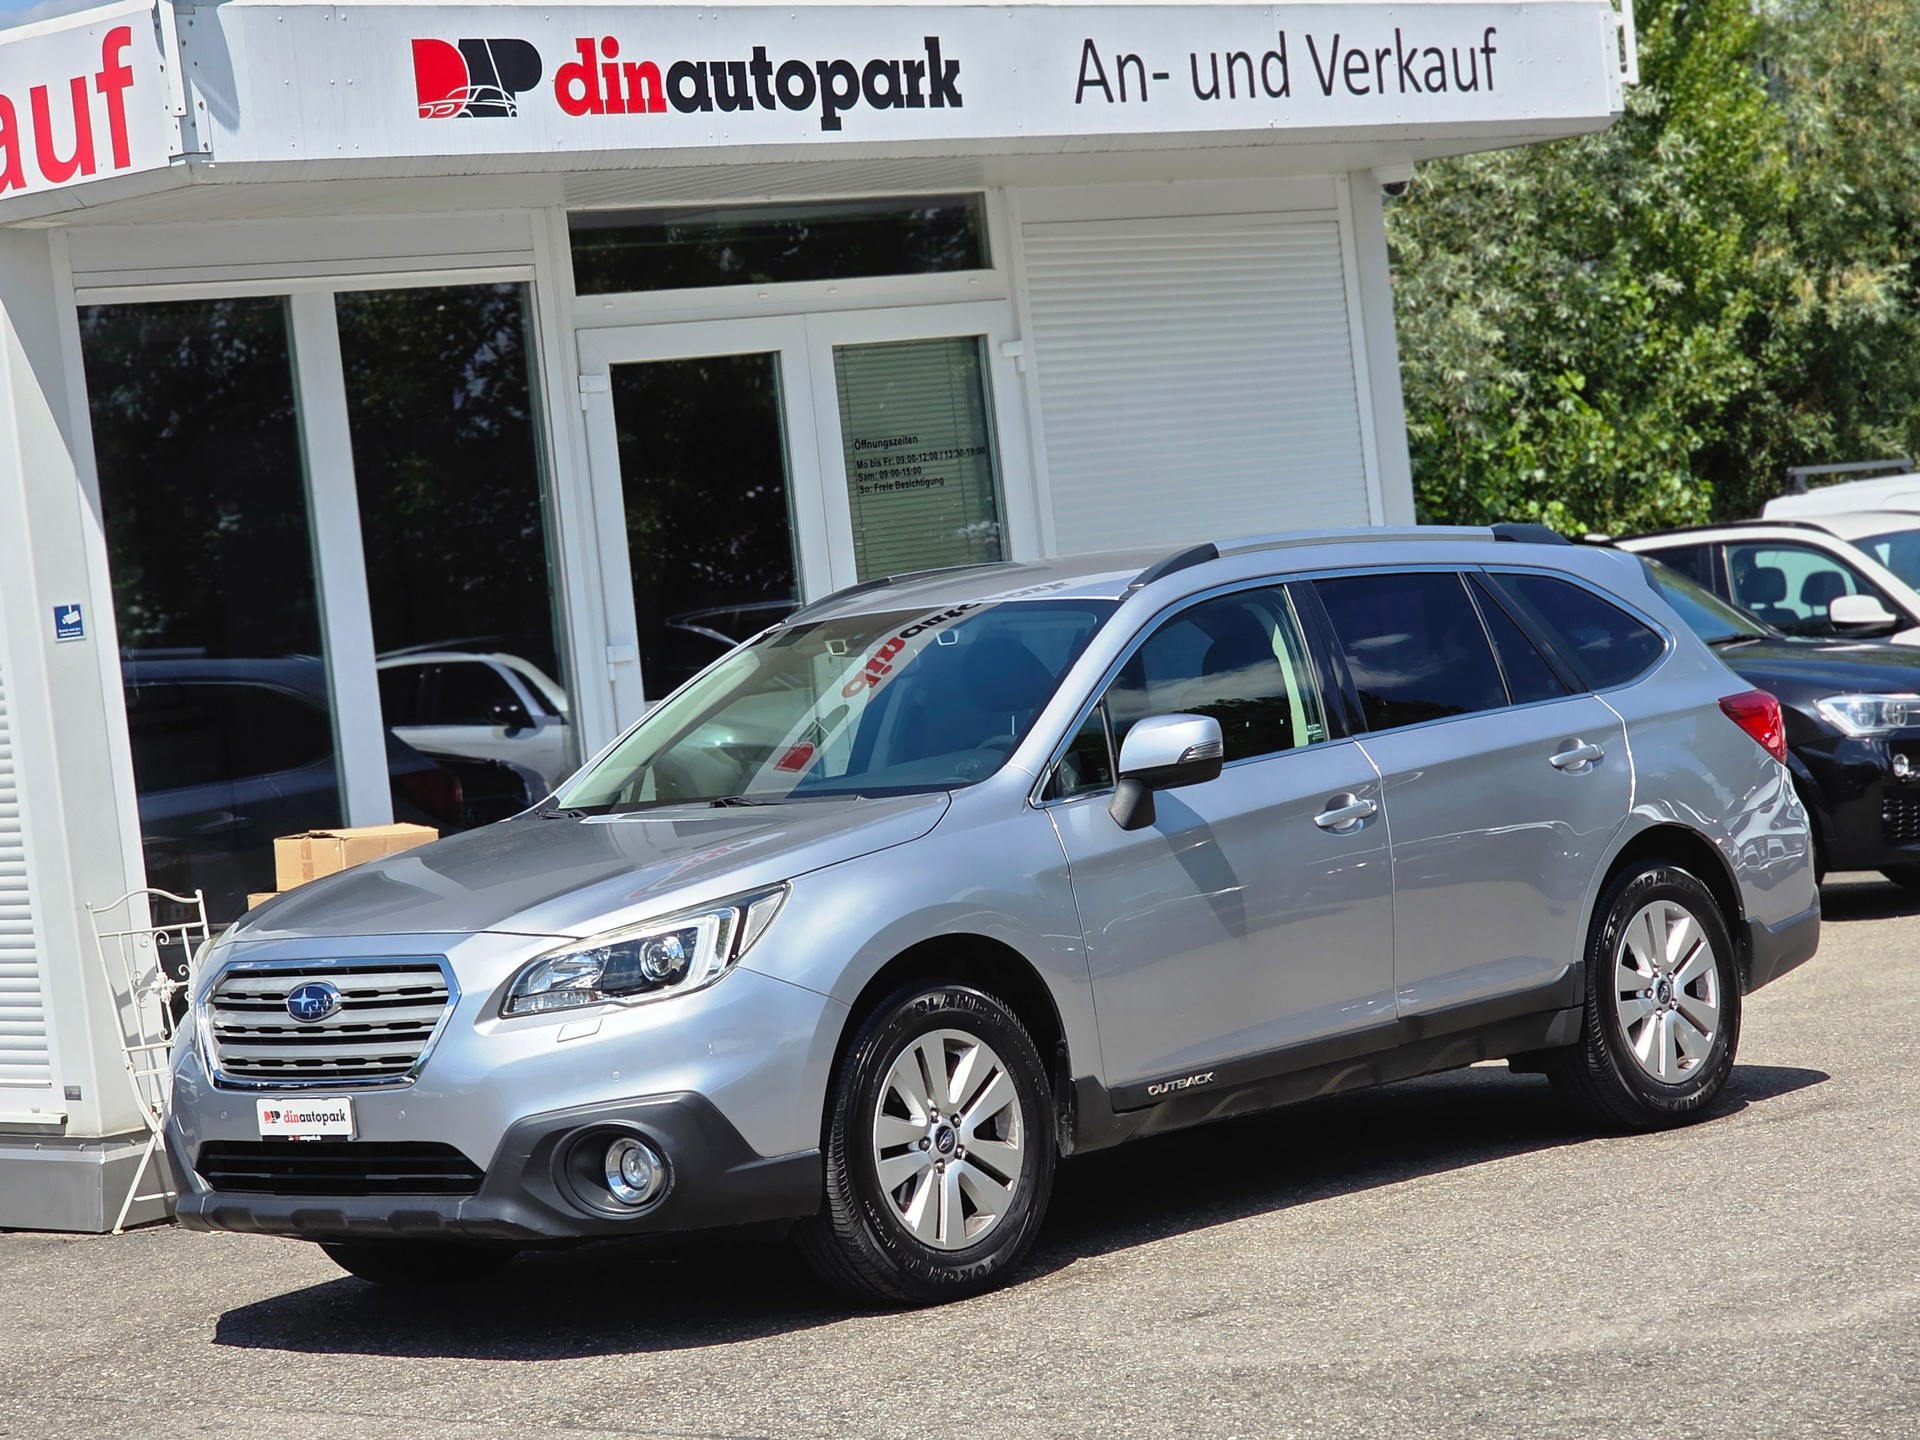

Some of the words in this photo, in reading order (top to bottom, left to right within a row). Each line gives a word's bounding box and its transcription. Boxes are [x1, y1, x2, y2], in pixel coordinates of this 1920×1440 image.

[1074, 38, 1170, 104] An-
[1189, 30, 1291, 101] und
[1305, 26, 1497, 97] Verkauf
[554, 35, 963, 131] dinautopark
[854, 435, 919, 450] Öffnungszeiten
[856, 460, 869, 469] Mo
[870, 457, 882, 468] bis
[874, 481, 894, 493] Freie
[895, 476, 944, 491] Besichtigung
[1147, 1071, 1215, 1096] OUTBACK
[283, 1108, 347, 1126] dinautopark
